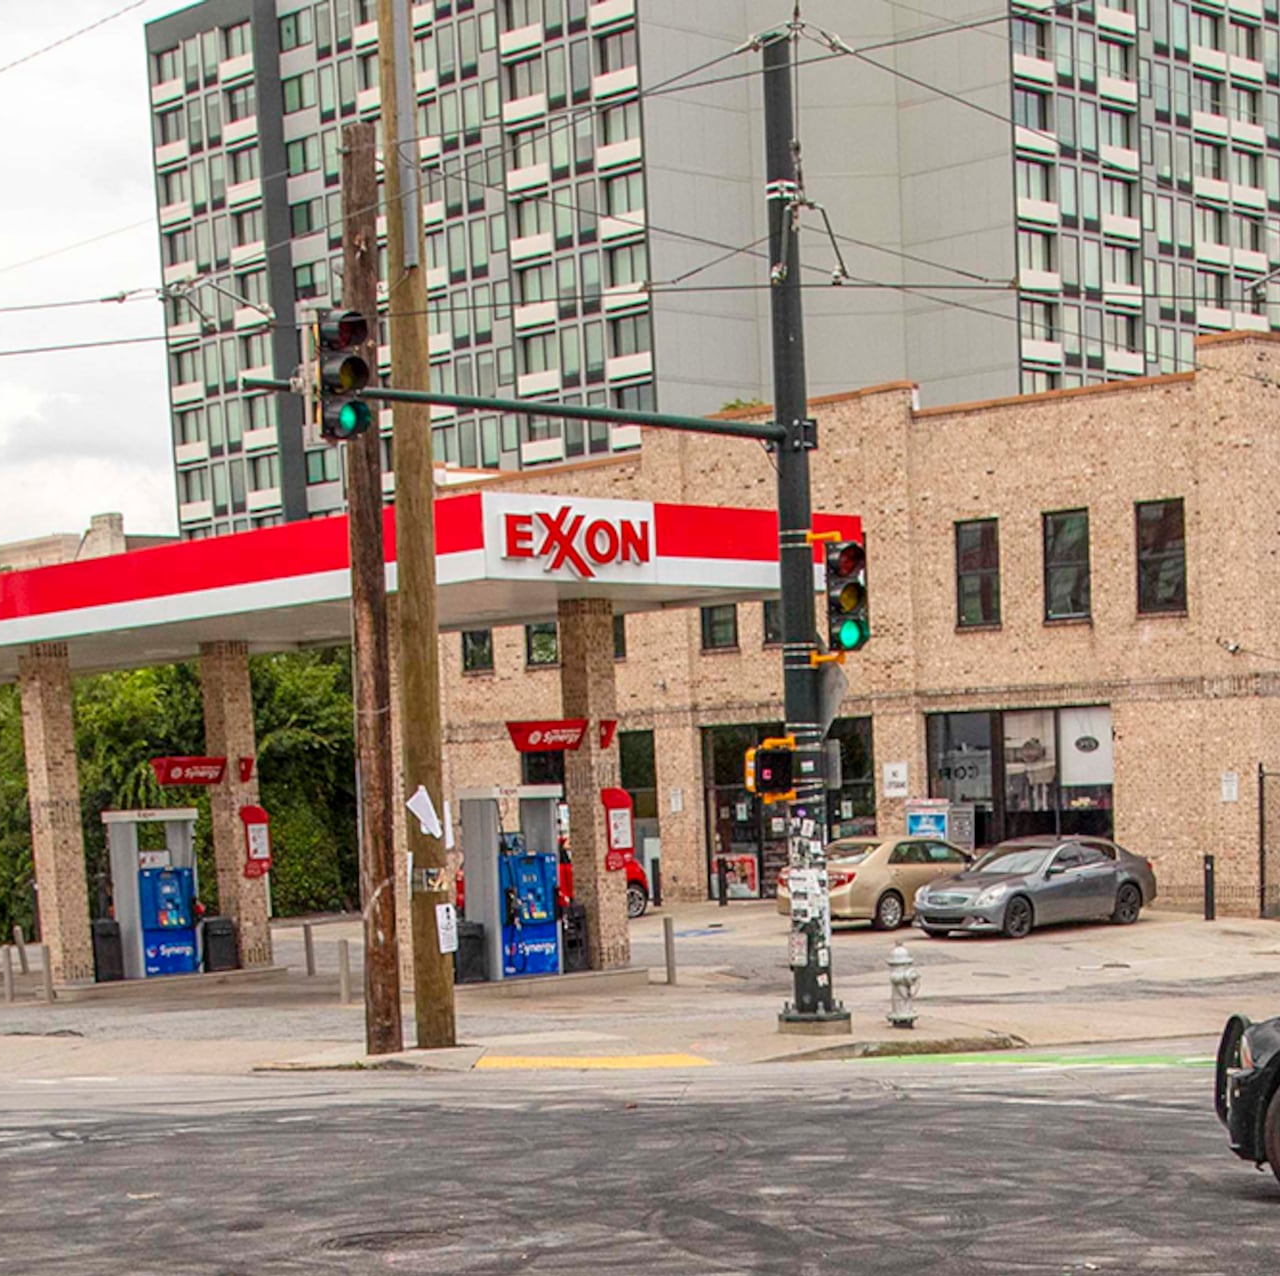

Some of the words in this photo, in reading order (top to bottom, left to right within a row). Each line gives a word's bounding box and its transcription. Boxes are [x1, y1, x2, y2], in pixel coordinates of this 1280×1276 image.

[503, 506, 651, 579] EXXON
[542, 731, 581, 744] Synergy
[184, 767, 221, 779] Synergy
[518, 941, 557, 954] Synergy
